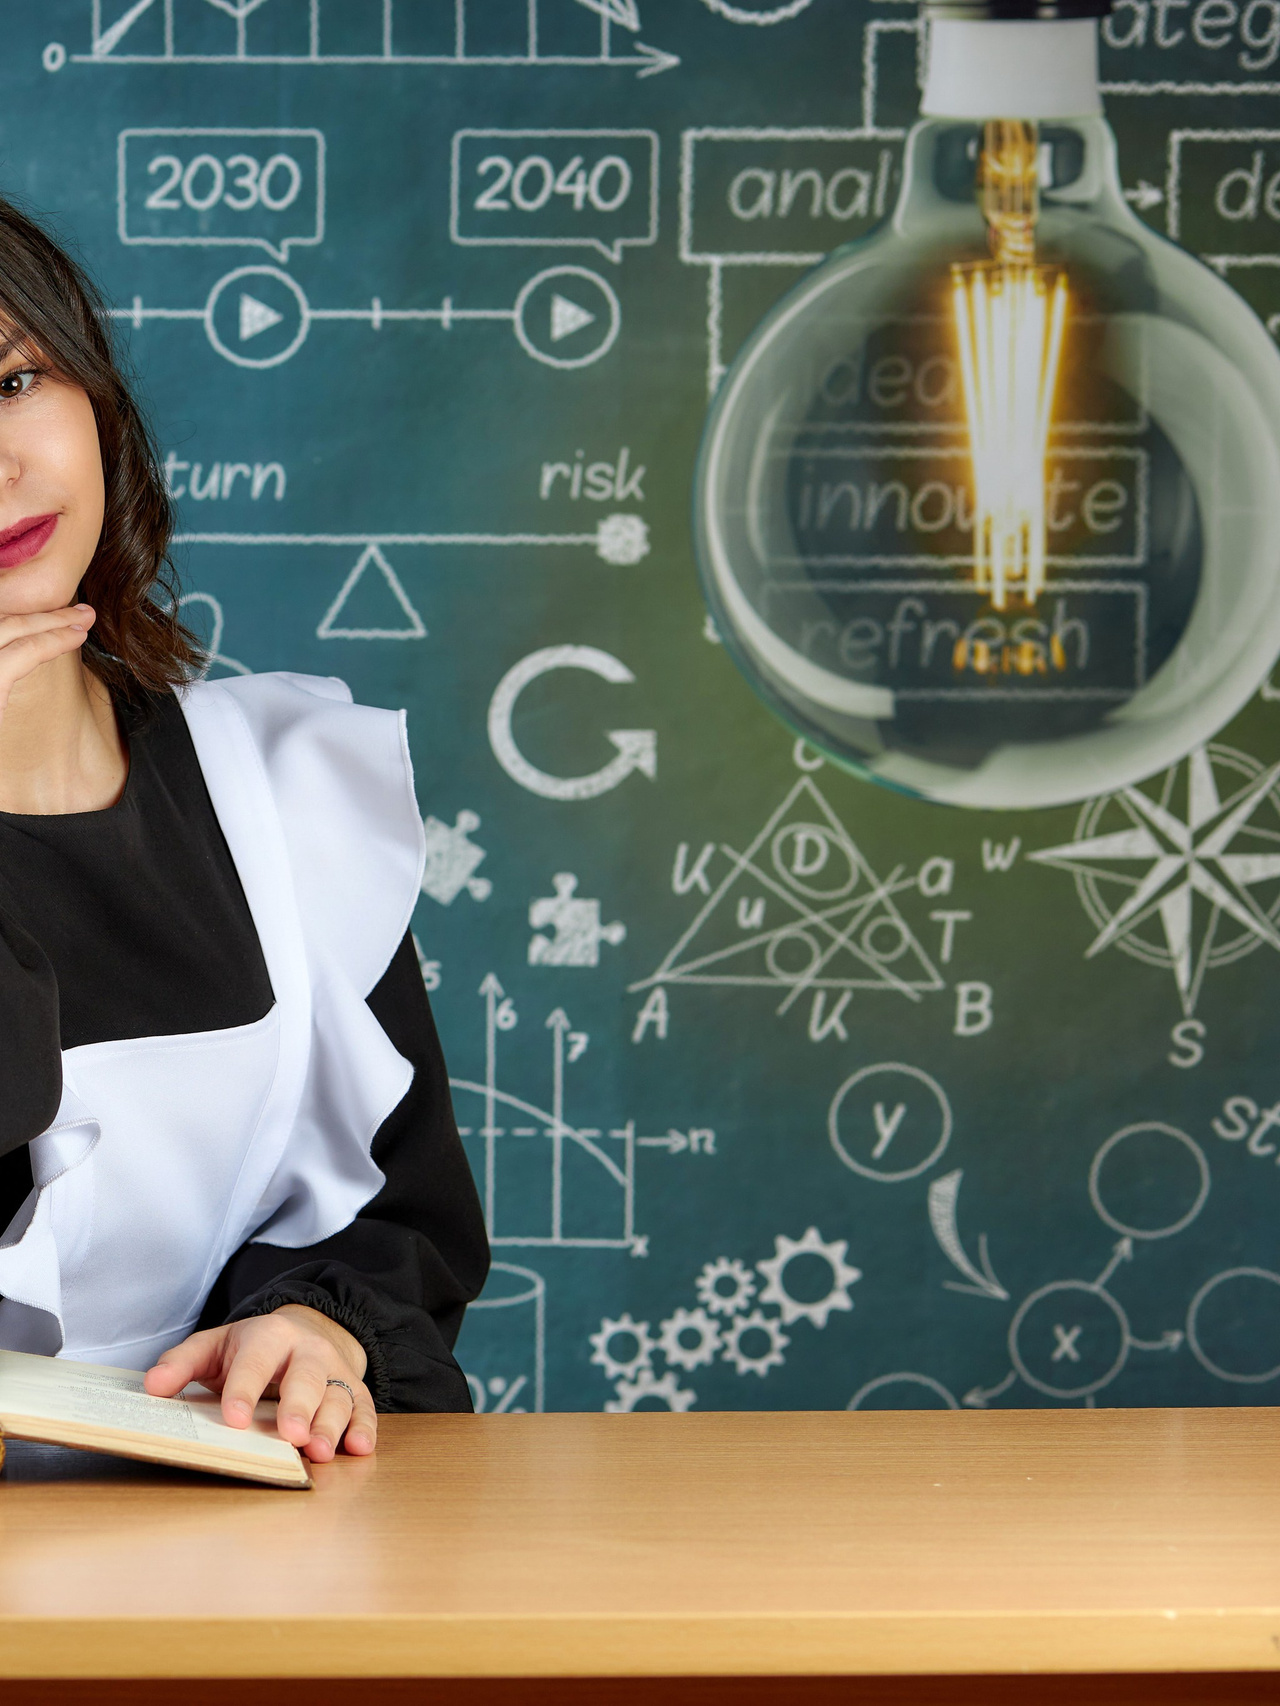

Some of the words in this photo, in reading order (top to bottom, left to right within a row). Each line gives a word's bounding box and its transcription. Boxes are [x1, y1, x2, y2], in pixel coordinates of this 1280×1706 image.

[145, 154, 302, 211] 2030
[474, 155, 632, 212] 2040
[727, 149, 900, 221] anal
[538, 447, 646, 501] risk
[796, 462, 1128, 534] innote
[798, 598, 1090, 673] refresh
[792, 831, 830, 876] D
[928, 910, 972, 964] T
[495, 998, 518, 1031] 6
[631, 986, 669, 1044] A
[953, 982, 993, 1036] B
[566, 1031, 589, 1063] 7
[1168, 1018, 1207, 1069] S
